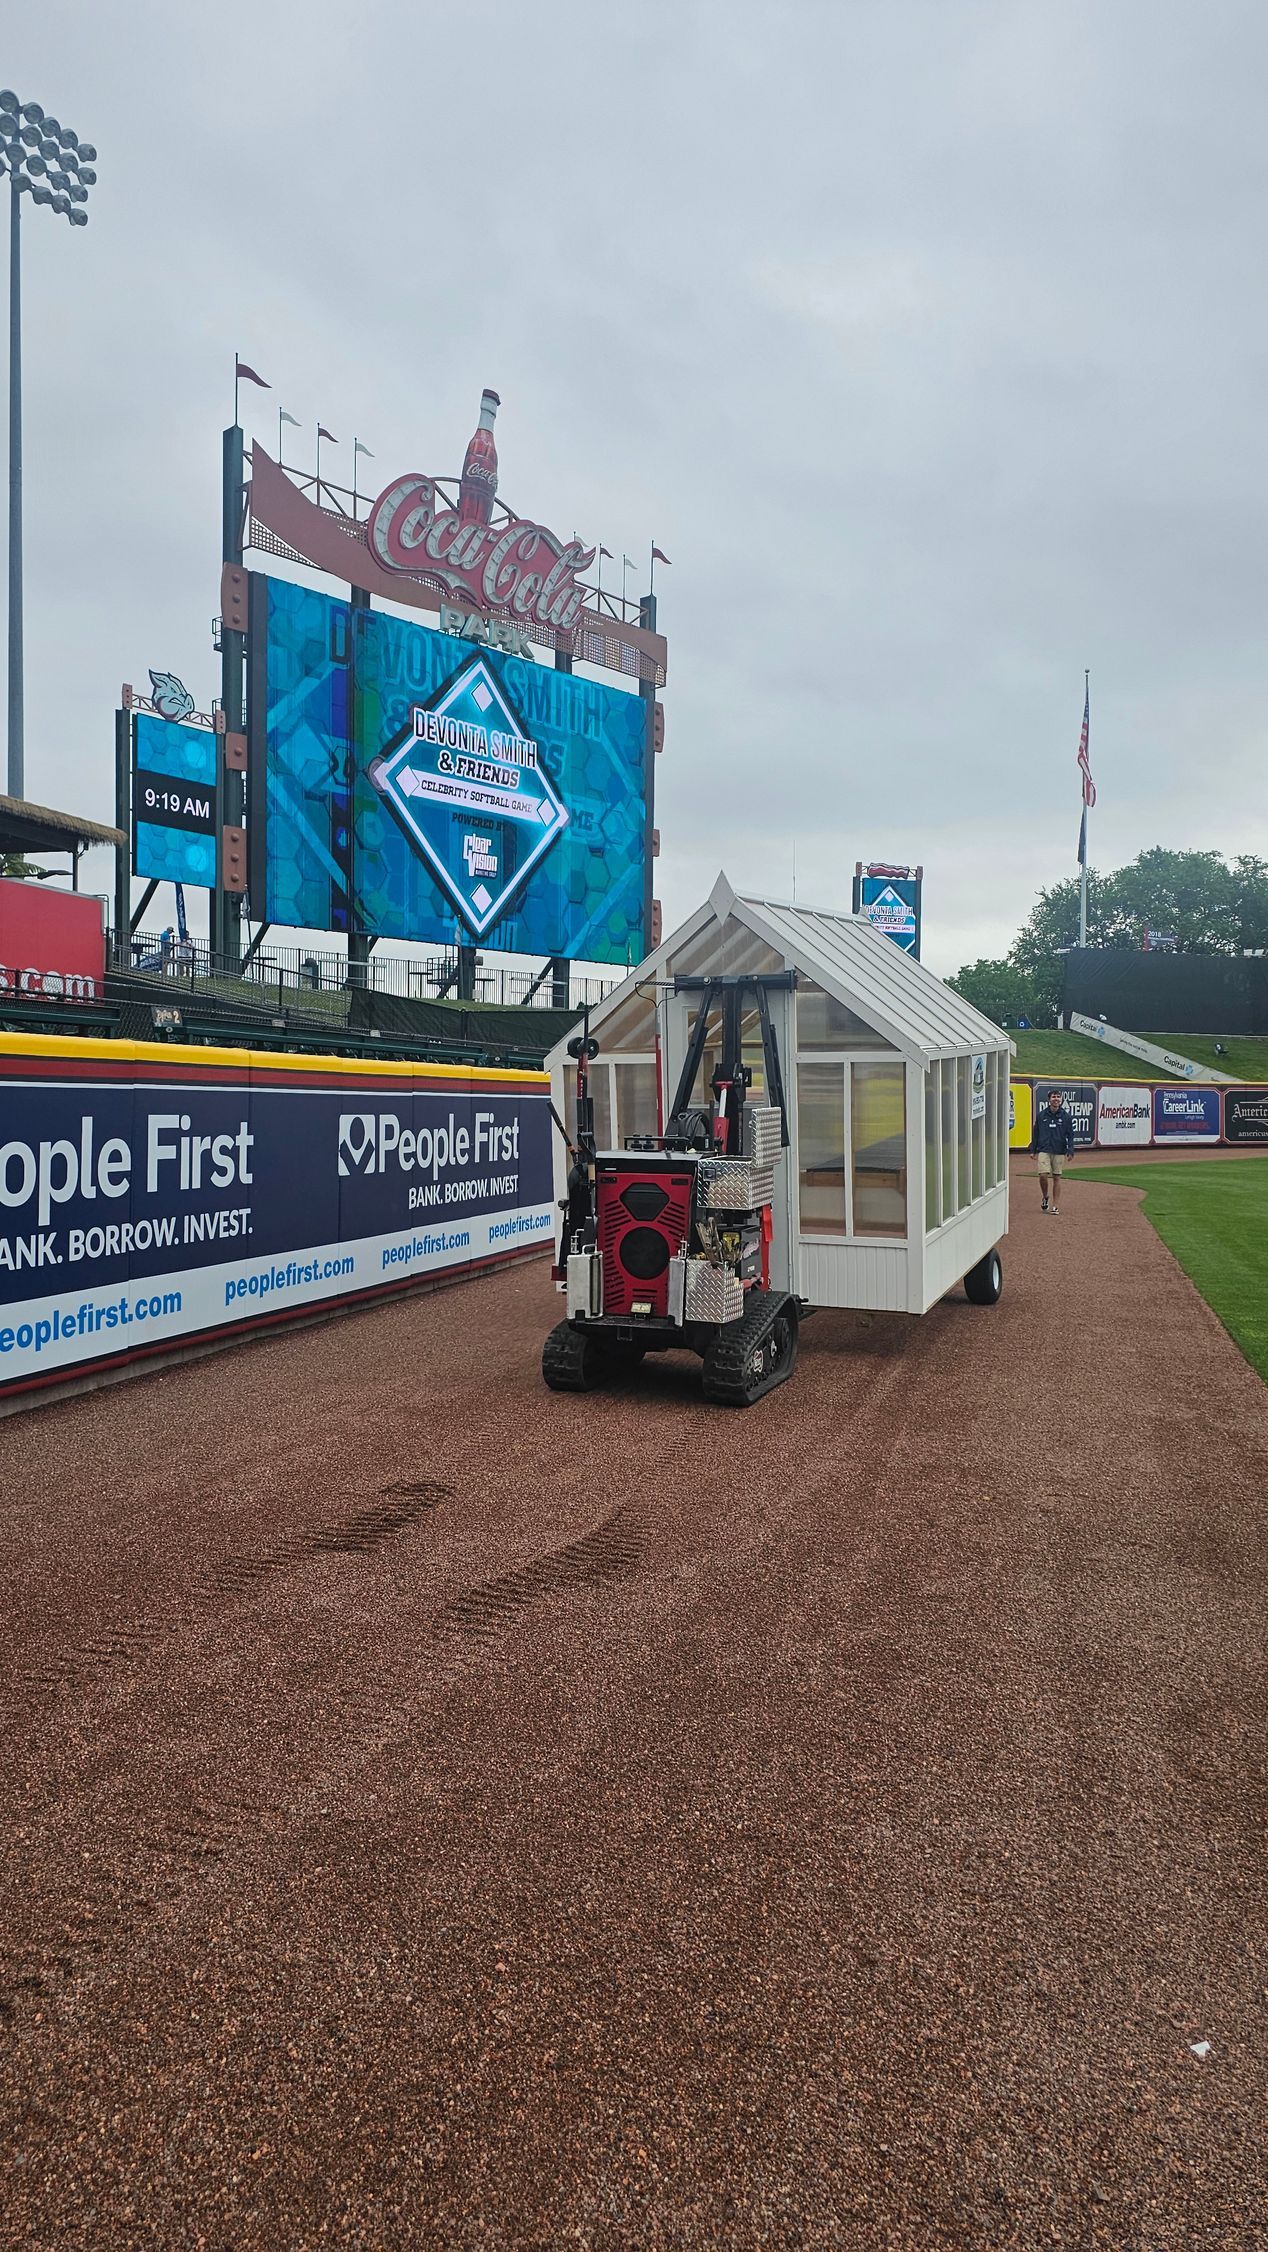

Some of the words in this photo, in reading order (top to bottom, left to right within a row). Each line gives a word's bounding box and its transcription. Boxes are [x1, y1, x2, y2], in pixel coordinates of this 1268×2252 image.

[374, 478, 595, 630] Coca-Cola
[440, 604, 534, 658] PARK
[414, 707, 488, 756] DEVONTA
[490, 729, 538, 768] SMITH
[438, 750, 454, 775] &
[457, 755, 519, 788] FRIENDS
[145, 788, 180, 812] 9:19
[183, 797, 210, 819] AM
[421, 780, 468, 799] CELEBRITY
[470, 791, 509, 808] SOFTBALL
[511, 800, 533, 813] GAME
[452, 812, 494, 830] POWERED
[463, 833, 491, 859] Clear
[1164, 1055, 1186, 1070] Capital
[1100, 1103, 1151, 1119] AmericanBank
[147, 1114, 254, 1193] First
[378, 1113, 470, 1181] People
[474, 1112, 519, 1163] First
[408, 1184, 443, 1210] BANK.
[444, 1178, 489, 1204] BORROW.
[69, 1217, 179, 1262] BORROW.
[183, 1208, 253, 1243] INVEST.
[489, 1213, 551, 1243] peoplefirst.com
[382, 1231, 470, 1269] peoplefirst.com
[225, 1256, 354, 1306] peoplefirst.com
